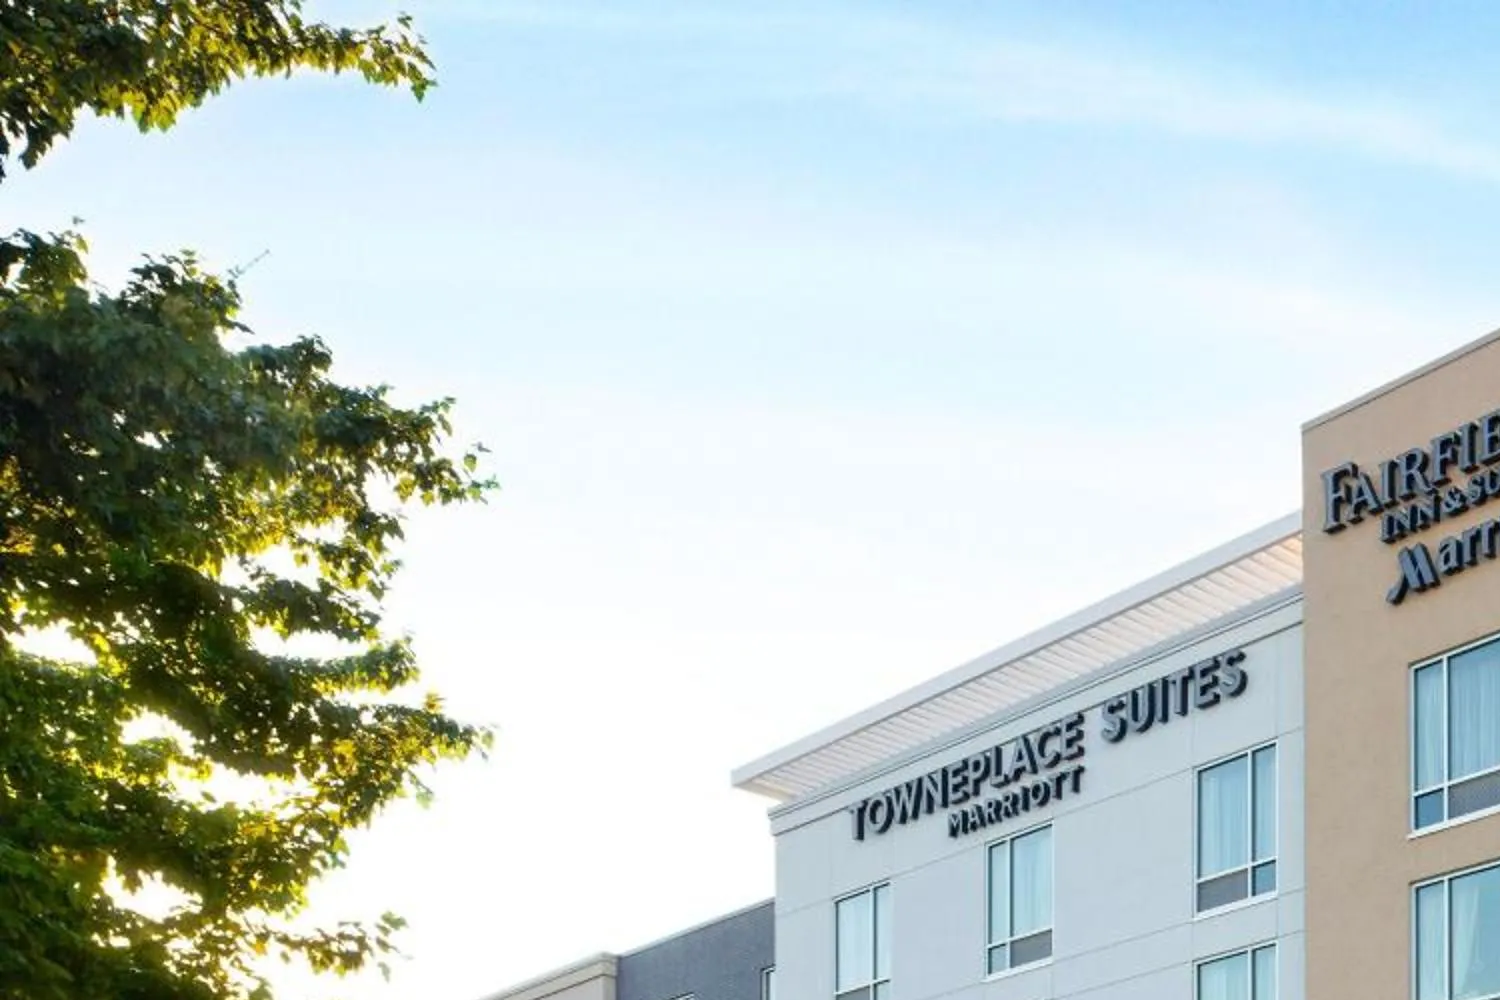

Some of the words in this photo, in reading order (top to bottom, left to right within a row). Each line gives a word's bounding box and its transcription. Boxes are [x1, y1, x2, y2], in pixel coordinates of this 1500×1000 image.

[1380, 494, 1441, 544] INN
[849, 711, 1086, 841] TOWNEPLACE
[1101, 648, 1249, 744] SUITES
[947, 764, 1086, 839] MARRIOTT
